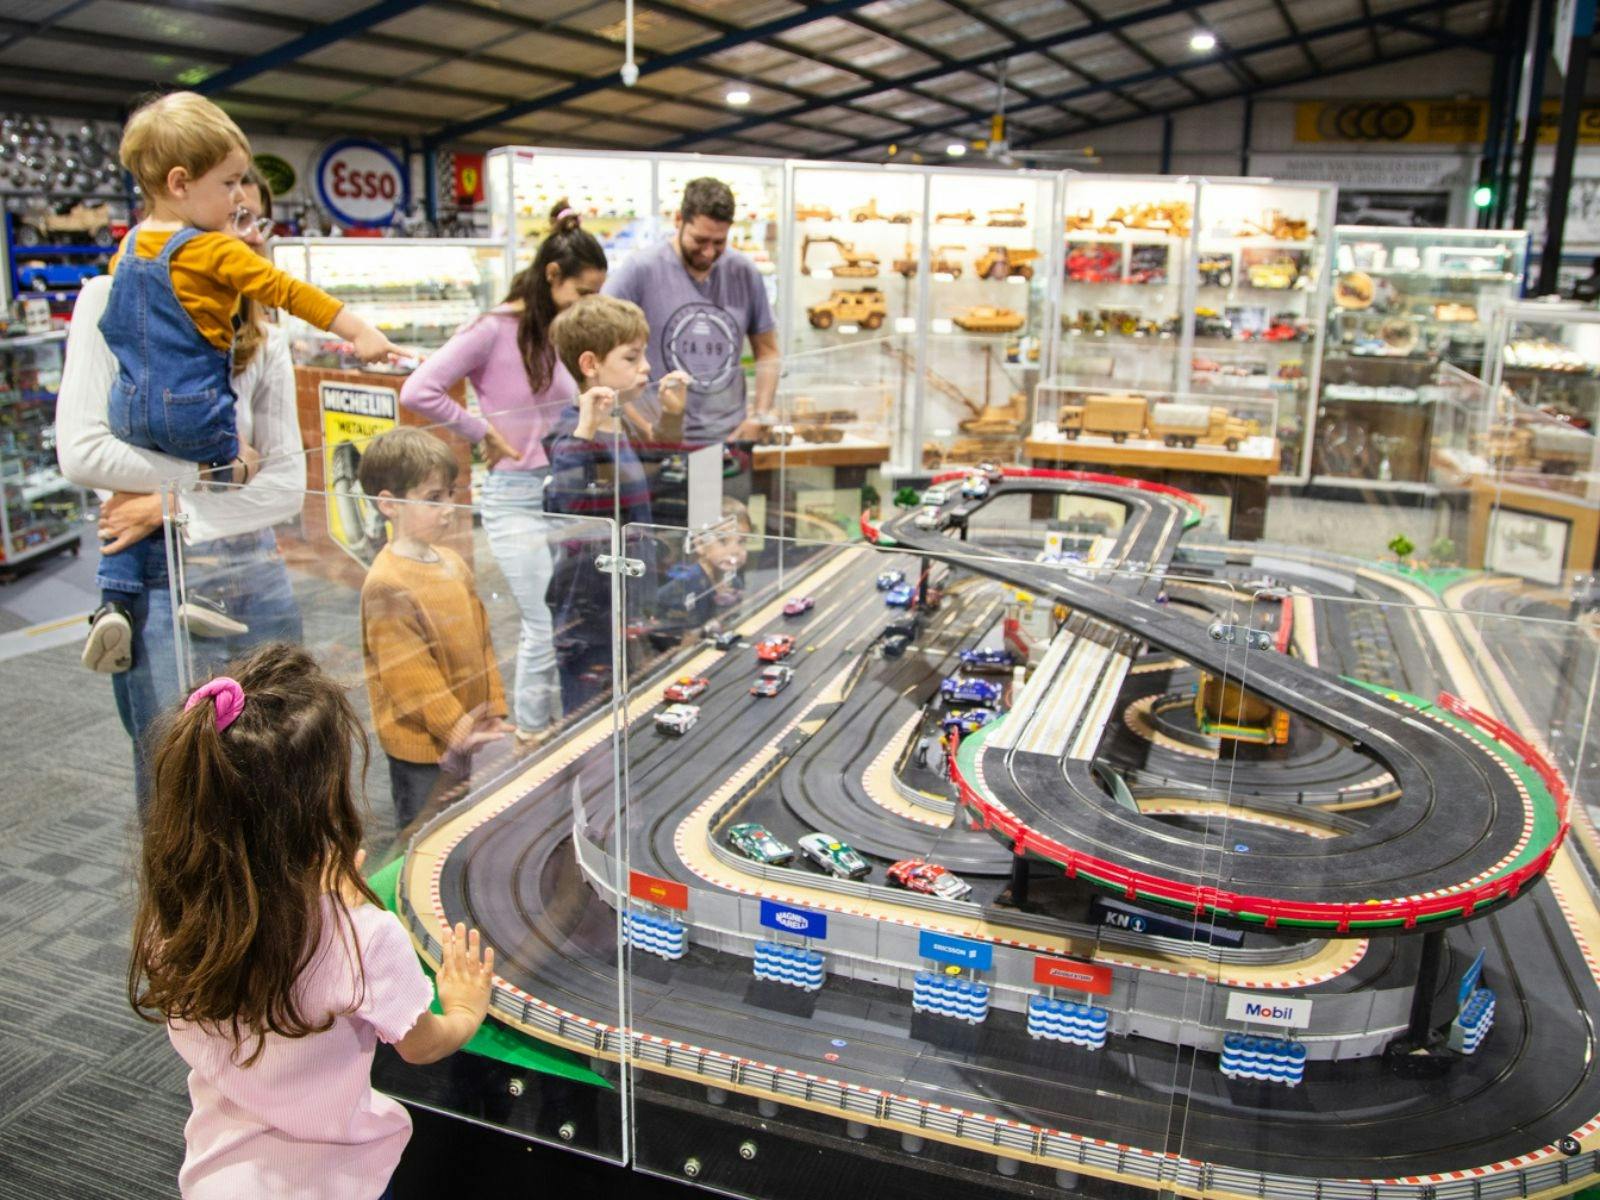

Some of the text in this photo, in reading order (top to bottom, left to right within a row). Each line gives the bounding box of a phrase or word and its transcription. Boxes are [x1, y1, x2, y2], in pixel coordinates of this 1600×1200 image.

[324, 389, 394, 417] MICHELIN
[1106, 911, 1130, 928] KN
[1246, 1003, 1293, 1020] Mobil
